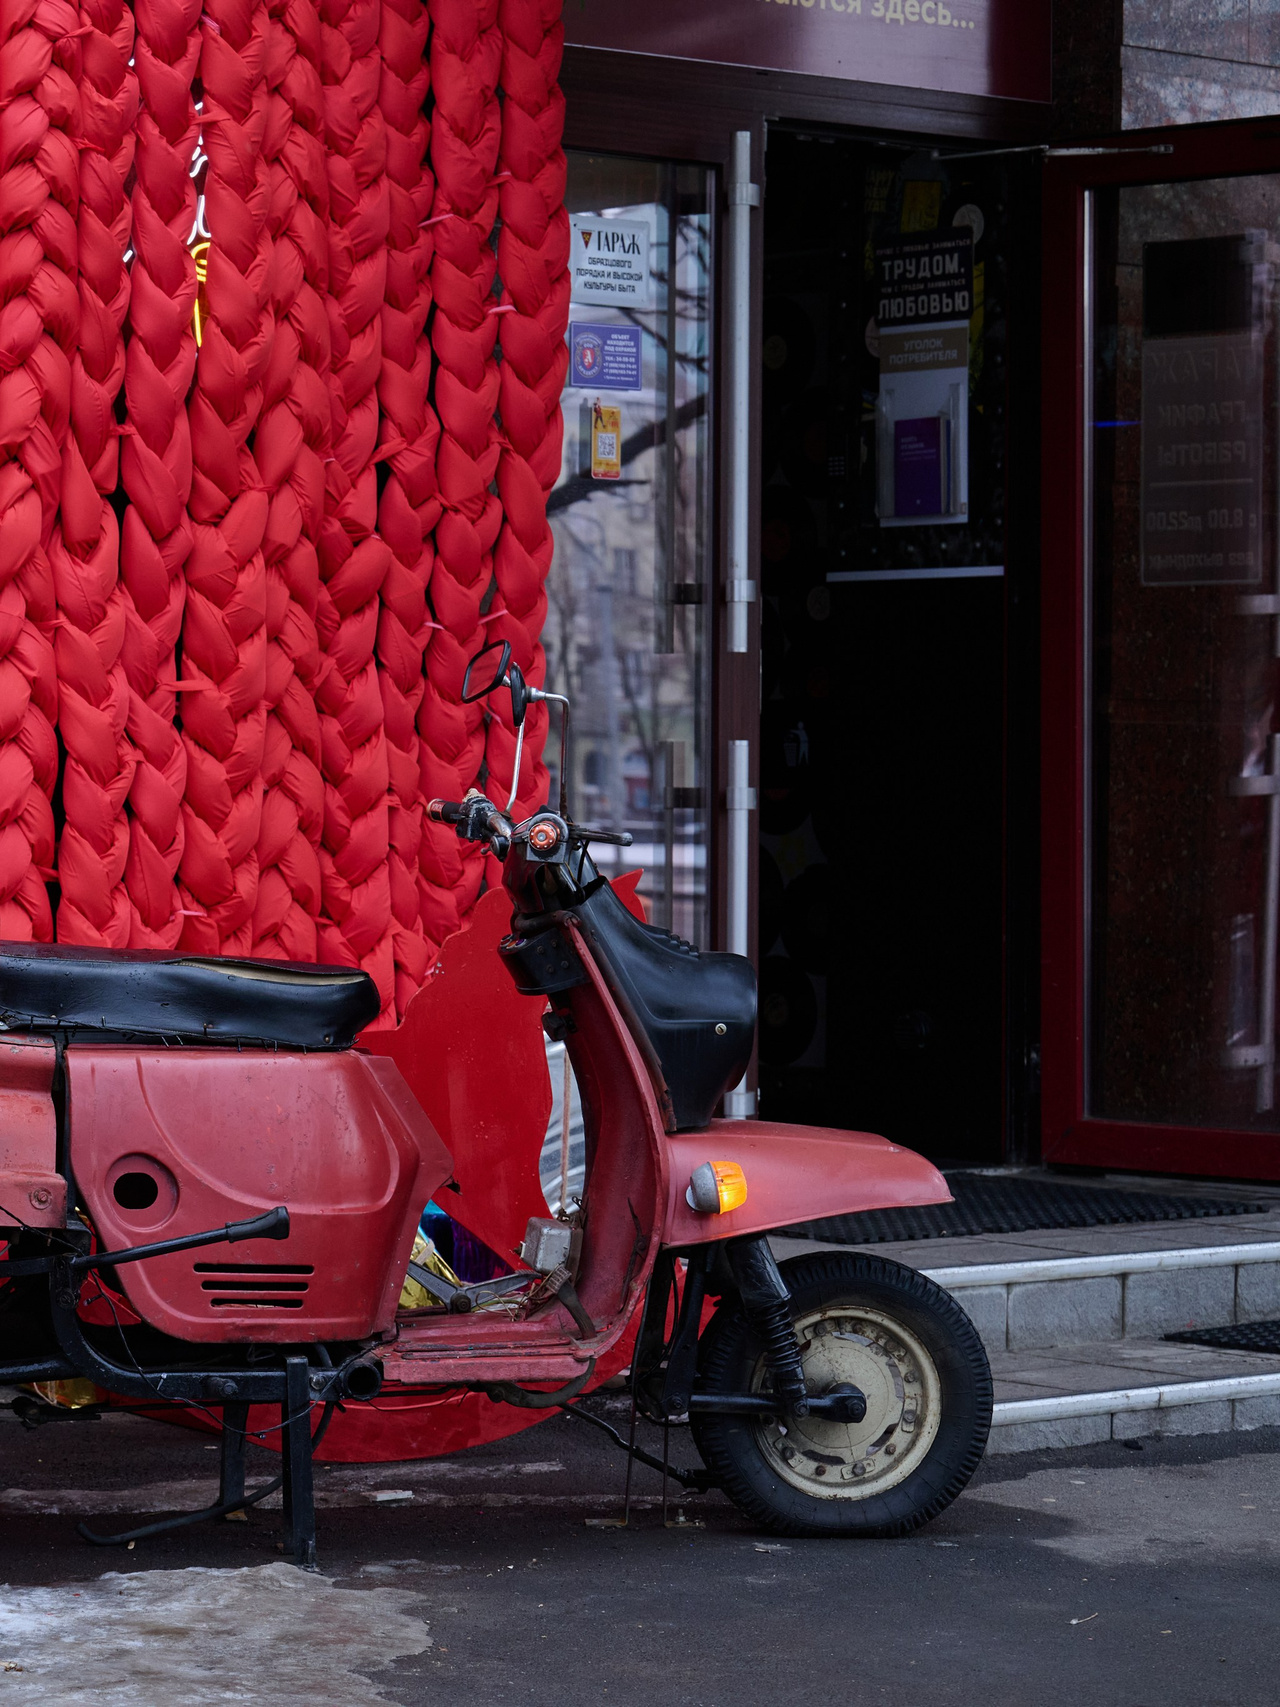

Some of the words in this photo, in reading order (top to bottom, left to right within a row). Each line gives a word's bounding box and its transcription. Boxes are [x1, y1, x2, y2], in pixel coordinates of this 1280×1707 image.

[870, 0, 975, 29] здесь...
[597, 230, 641, 255] ГАРАЖ
[588, 256, 632, 269] ОБРАЗЦОВОГО
[576, 268, 605, 279] ПОРЯДКА
[606, 271, 611, 279] И
[612, 271, 643, 282] ВЫСОКОЙ
[583, 281, 617, 292] КУЛЬТУРЫ
[618, 283, 636, 293] БЫТА
[878, 290, 970, 320] ЛЮБОВЬЮ
[904, 336, 943, 351] УГОЛОК
[889, 349, 958, 365] ПОТРЕБИТЕЛЯ
